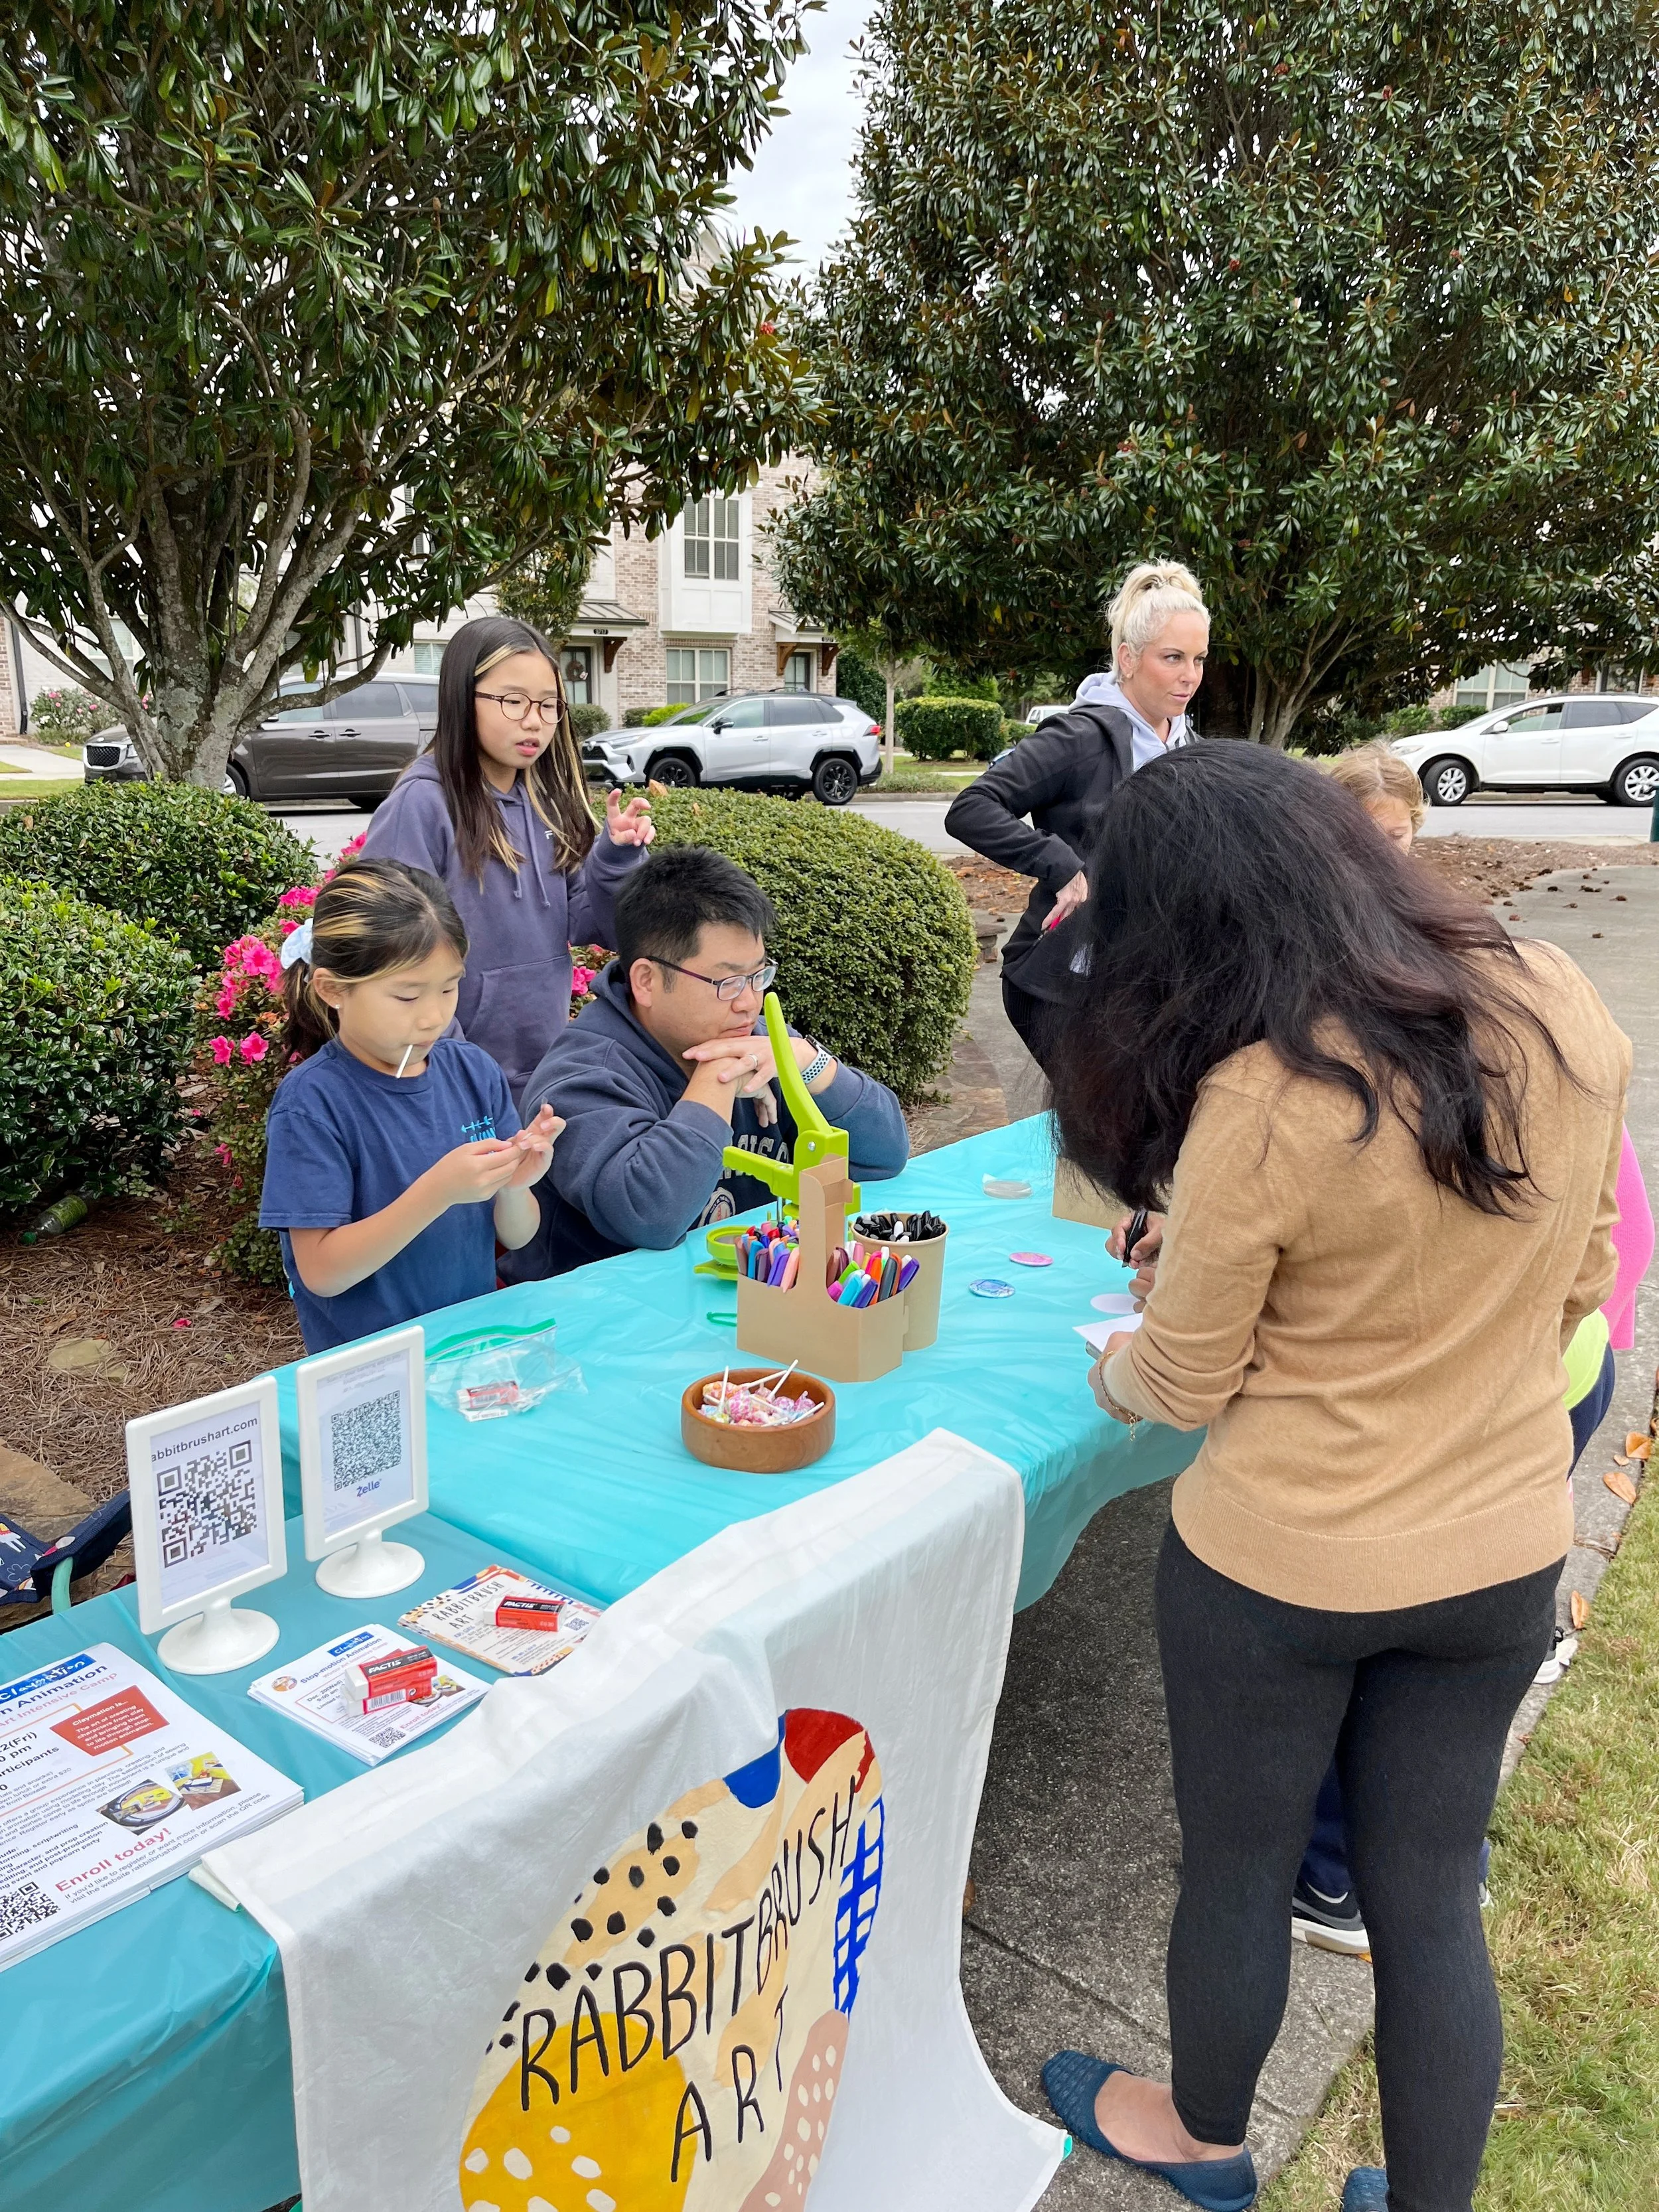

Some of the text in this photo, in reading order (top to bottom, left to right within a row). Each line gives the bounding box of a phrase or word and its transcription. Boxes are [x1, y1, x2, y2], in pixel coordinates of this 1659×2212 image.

[151, 1418, 258, 1462] abbitbrushart.com
[356, 1481, 380, 1497] Zelle
[432, 1581, 504, 1621] RABBITBRUSH
[449, 1614, 474, 1629] ART
[300, 1657, 346, 1683] Stop-motion
[346, 1638, 382, 1658] Animation
[368, 1660, 401, 1674] FACTIS
[17, 1690, 77, 1718] Intensive
[80, 1672, 117, 1690] Camp
[18, 1666, 107, 1708] Animation
[72, 1706, 114, 1725] Claymation
[84, 1714, 145, 1741] and bringing them
[106, 1725, 133, 1737] through
[133, 1717, 151, 1726] stop-
[109, 1705, 136, 1718] creating
[399, 1703, 441, 1729] Enroll today!
[0, 1732, 36, 1752] 2(Fri)
[77, 1722, 112, 1739] characters
[94, 1722, 153, 1749] motion animation.
[0, 1747, 58, 1776] rticipants
[9, 1745, 31, 1758] pm
[5, 1828, 18, 1836] and
[19, 1817, 42, 1829] stories
[42, 1807, 62, 1818] come
[82, 1786, 108, 1799] through
[108, 1769, 142, 1787] movement
[155, 1753, 177, 1764] unique
[7, 1812, 40, 1830] animation
[40, 1803, 60, 1813] using
[60, 1788, 91, 1804] modeling
[165, 1743, 186, 1753] seeing
[13, 1787, 32, 1797] lunch
[41, 1775, 58, 1784] extra
[27, 1771, 53, 1785] snacks)
[3, 1815, 22, 1826] offers
[29, 1802, 48, 1813] group
[50, 1784, 86, 1803] experience
[6, 1797, 22, 1805] from
[19, 1820, 47, 1835] Register
[49, 1811, 66, 1820] early
[76, 1797, 95, 1807] spots
[108, 1779, 131, 1792] limited!
[7, 1854, 43, 1873] character,
[44, 1845, 58, 1854] and
[60, 1836, 78, 1847] prop
[79, 1821, 108, 1837] creation
[29, 1860, 43, 1869] and
[44, 1830, 102, 1861] post-production
[33, 1824, 78, 1847] scriptwriting
[72, 1882, 94, 1896] you'd
[94, 1876, 108, 1884] like
[118, 1854, 146, 1872] register
[157, 1839, 175, 1850] want
[176, 1828, 195, 1840] more
[238, 1793, 261, 1806] please
[11, 1838, 100, 1883] event and popcorn party
[55, 1828, 171, 1891] Enroll today!
[70, 1893, 86, 1903] visit
[100, 1871, 130, 1887] website
[129, 1834, 198, 1872] rabbitbrushart.com
[208, 1818, 226, 1829] scan
[520, 1775, 858, 2111] RABBITBRUSH
[670, 1985, 788, 2183] ART
